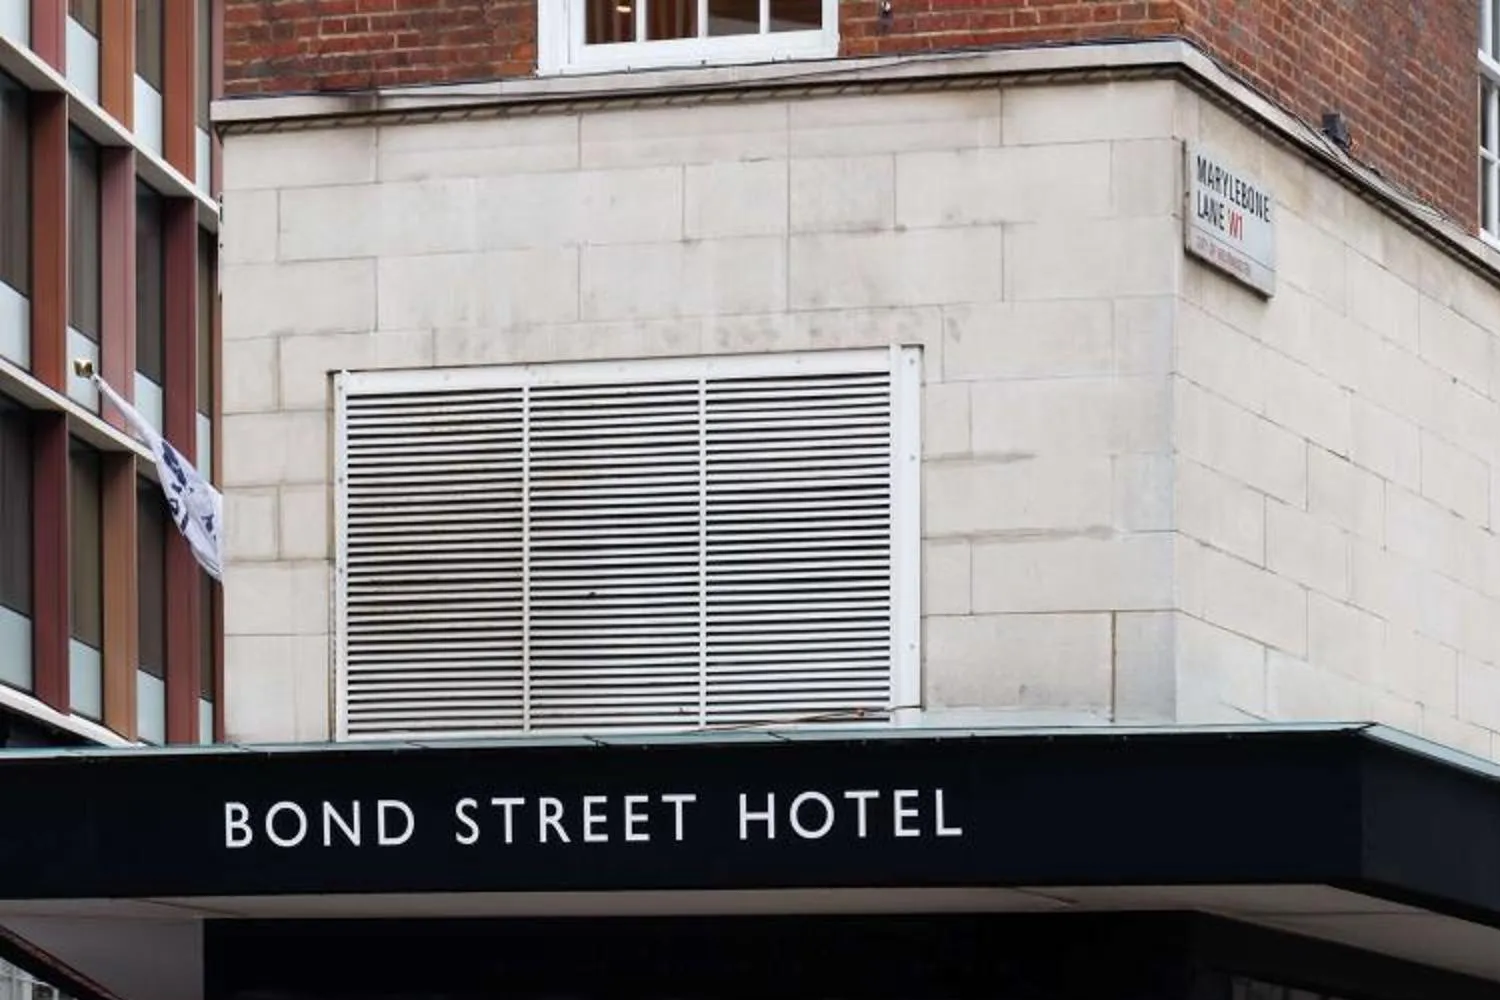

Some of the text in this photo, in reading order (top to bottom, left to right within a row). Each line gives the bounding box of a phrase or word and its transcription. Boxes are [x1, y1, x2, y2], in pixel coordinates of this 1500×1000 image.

[1197, 155, 1271, 223] MARYLEBONE
[1197, 189, 1225, 231] LANE
[224, 788, 963, 848] BOND STREET HOTEL
